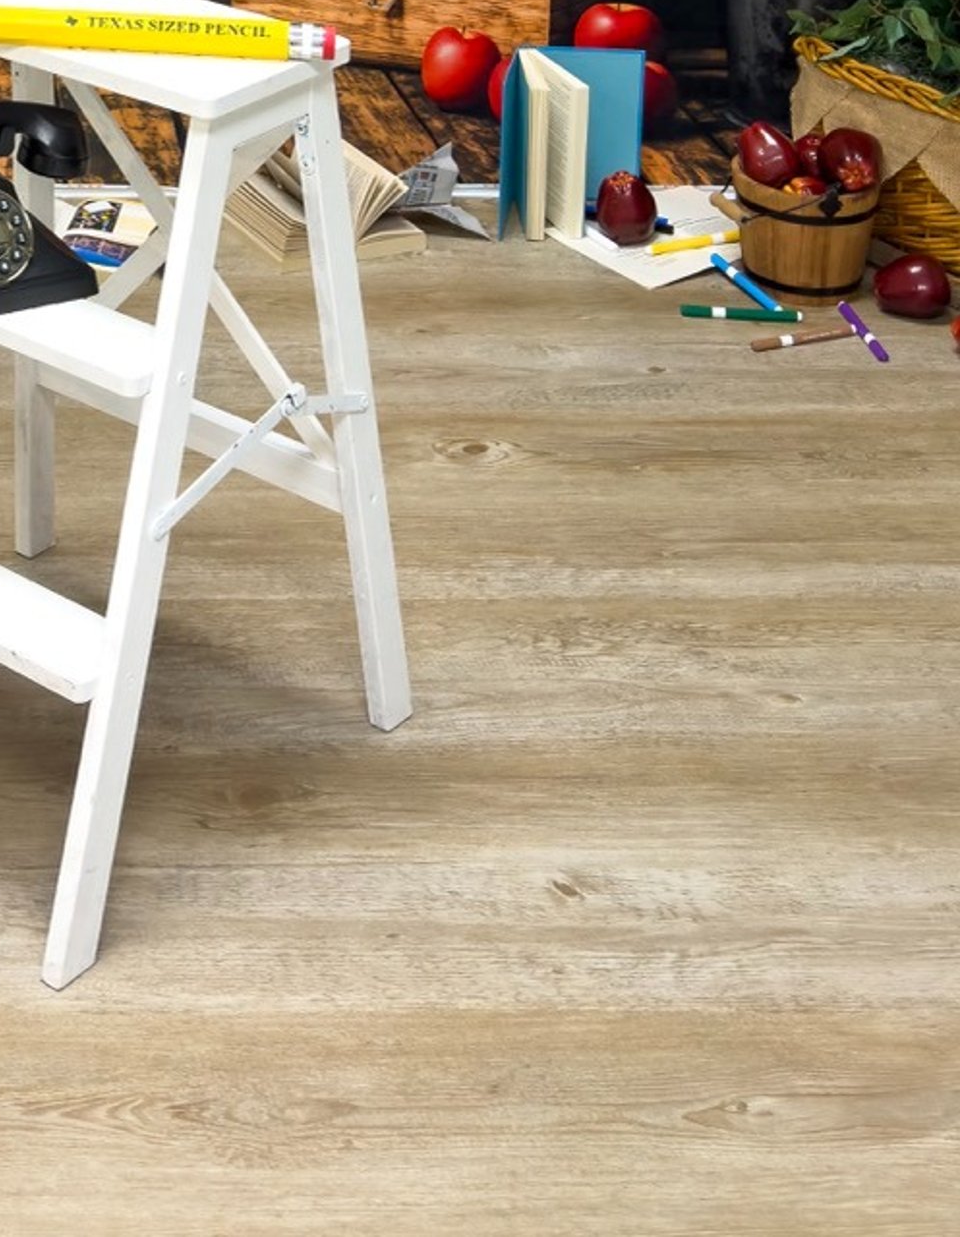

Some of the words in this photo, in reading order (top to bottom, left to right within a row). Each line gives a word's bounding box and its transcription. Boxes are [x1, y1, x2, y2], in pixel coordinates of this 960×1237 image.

[88, 15, 144, 30] TEXAS
[148, 19, 201, 34] SIZED
[204, 21, 271, 38] PENCIL
